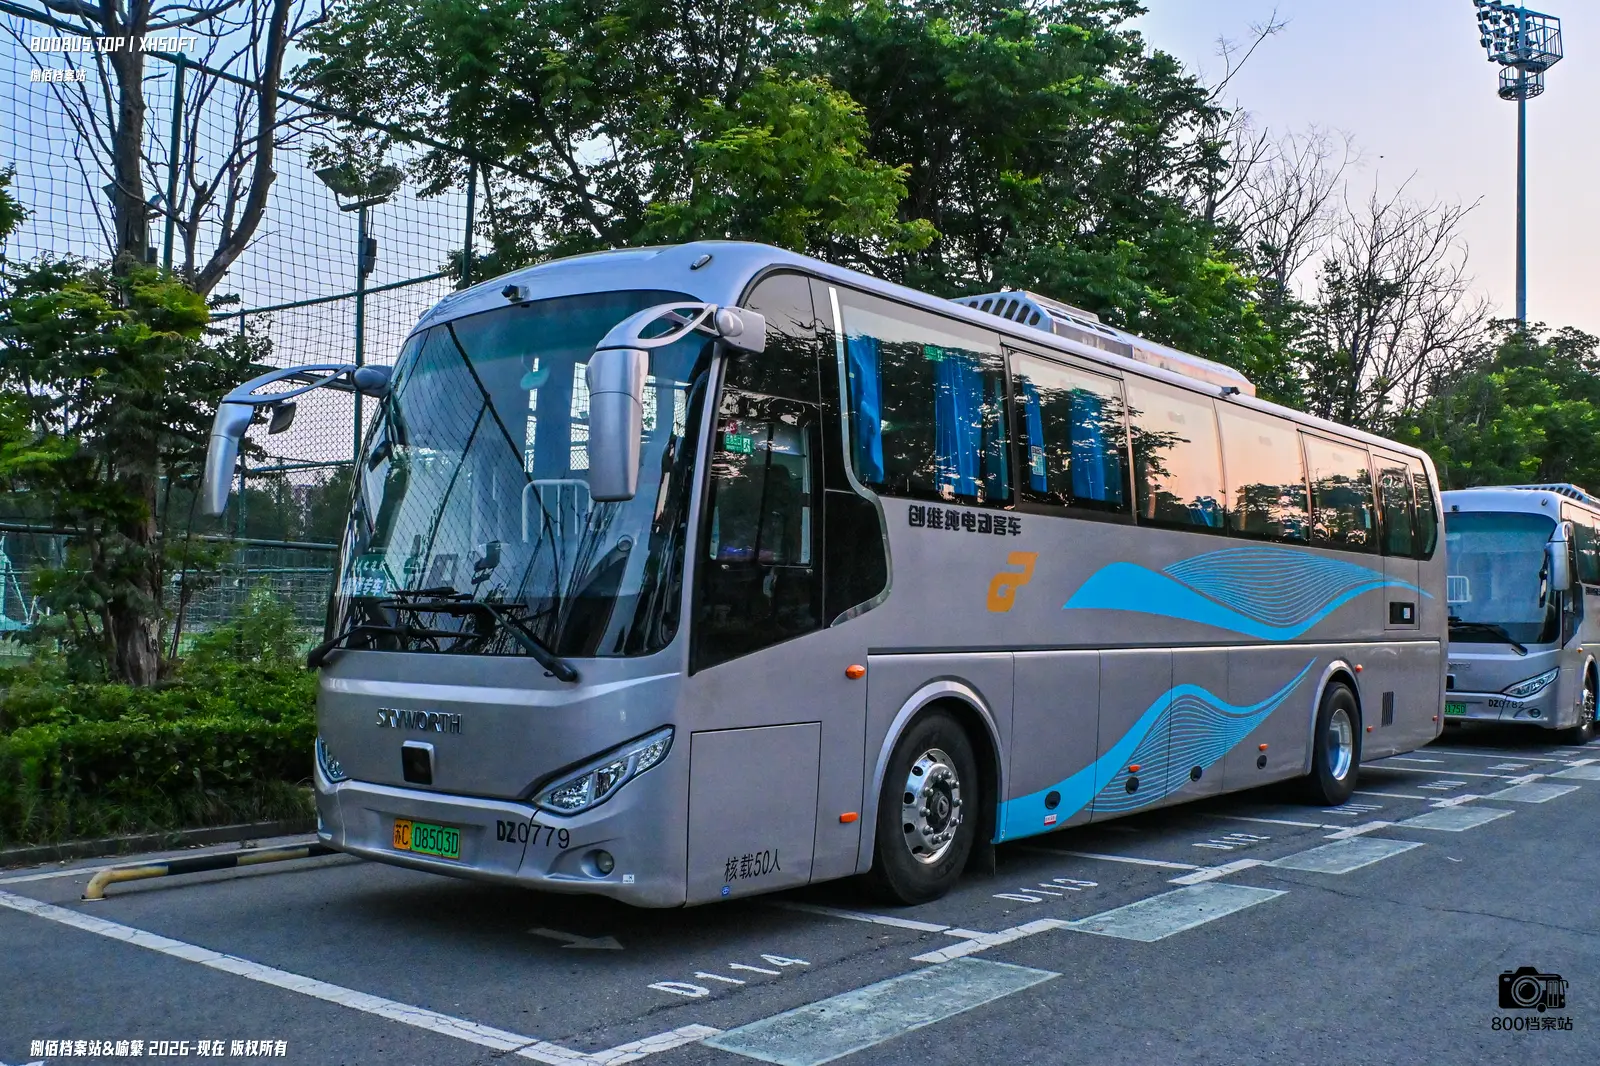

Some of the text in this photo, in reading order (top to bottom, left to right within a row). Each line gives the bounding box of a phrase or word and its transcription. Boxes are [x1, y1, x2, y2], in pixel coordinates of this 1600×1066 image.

[908, 504, 1022, 536] 创维纯电动客车
[1488, 699, 1525, 709] DZ0782
[376, 707, 464, 734] SKYWORTH
[496, 819, 570, 849] DZ0779
[725, 848, 781, 882] 核载50人
[992, 878, 1098, 903] D113
[647, 953, 811, 998] D114
